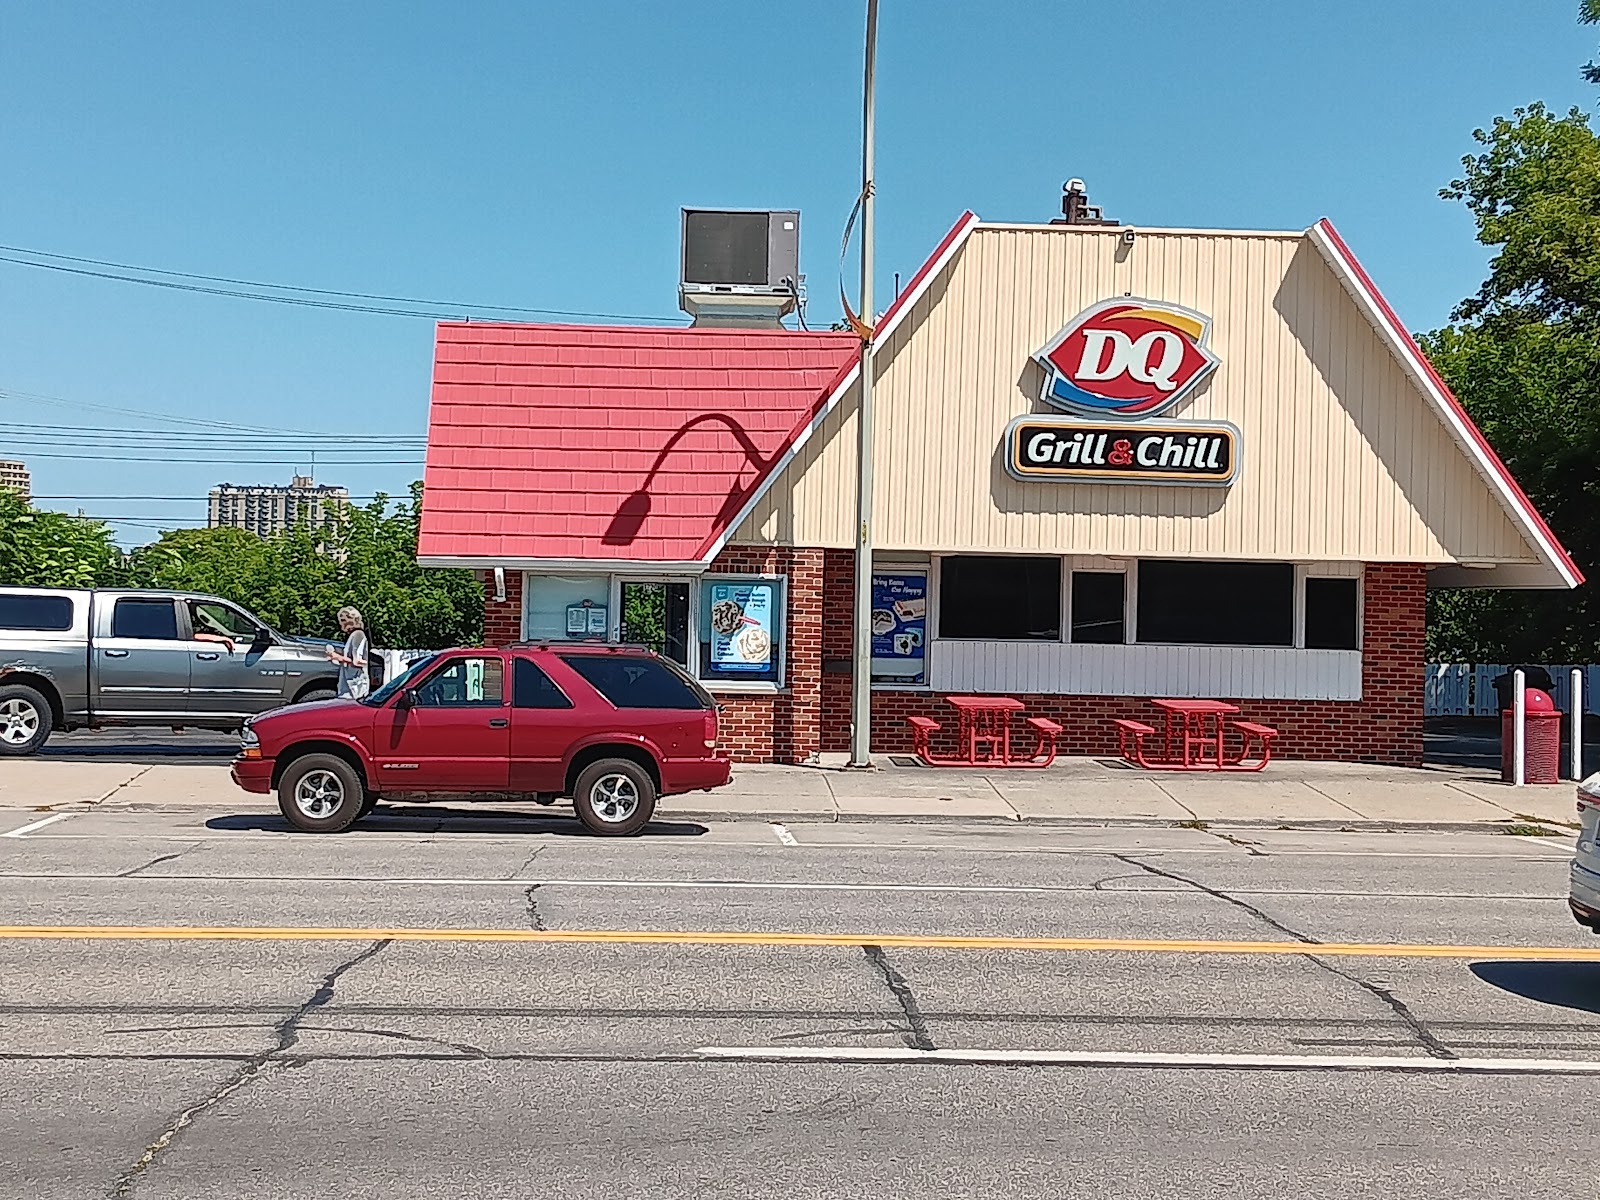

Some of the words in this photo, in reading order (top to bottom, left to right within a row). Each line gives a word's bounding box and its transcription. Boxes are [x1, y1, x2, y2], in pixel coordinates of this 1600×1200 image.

[1074, 329, 1184, 392] DQ
[1027, 432, 1108, 465] Grill
[1136, 436, 1222, 469] Chill
[902, 586, 923, 596] Happy
